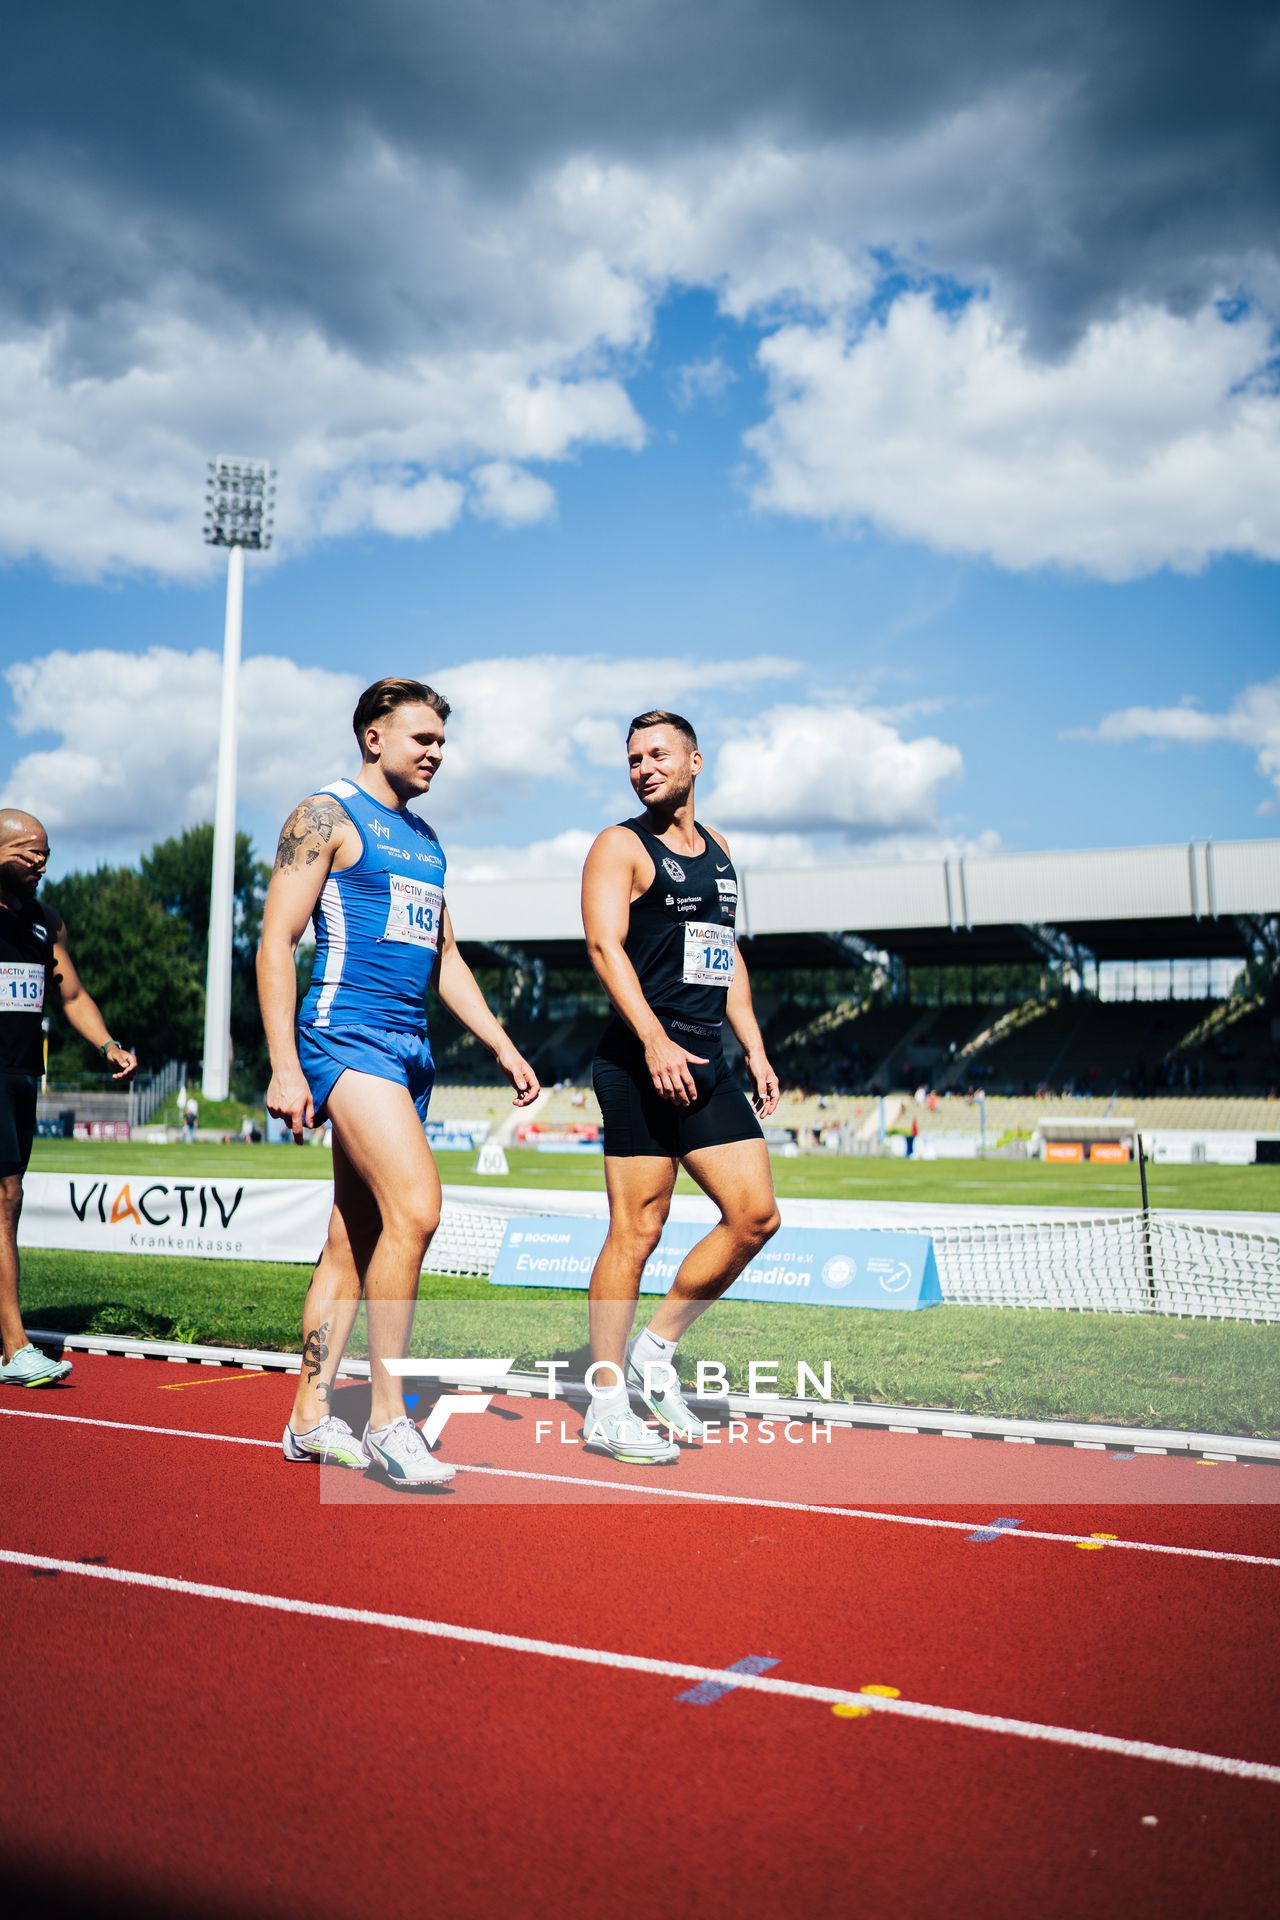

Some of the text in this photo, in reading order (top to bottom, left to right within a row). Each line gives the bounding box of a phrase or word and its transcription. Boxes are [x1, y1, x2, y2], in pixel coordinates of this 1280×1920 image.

[391, 881, 422, 896] VIACTIV
[677, 896, 702, 904] Sparkasse
[677, 904, 697, 912] Leipzig
[406, 903, 433, 932] 143
[689, 928, 720, 939] VIACTIV
[703, 947, 729, 970] 123
[9, 981, 37, 999] 113
[69, 1181, 244, 1229] VIACTIV
[130, 1233, 243, 1252] Krankenkasse
[525, 1233, 571, 1243] BOCHUM
[516, 1254, 597, 1273] Eventbü
[643, 1260, 678, 1278] ohr
